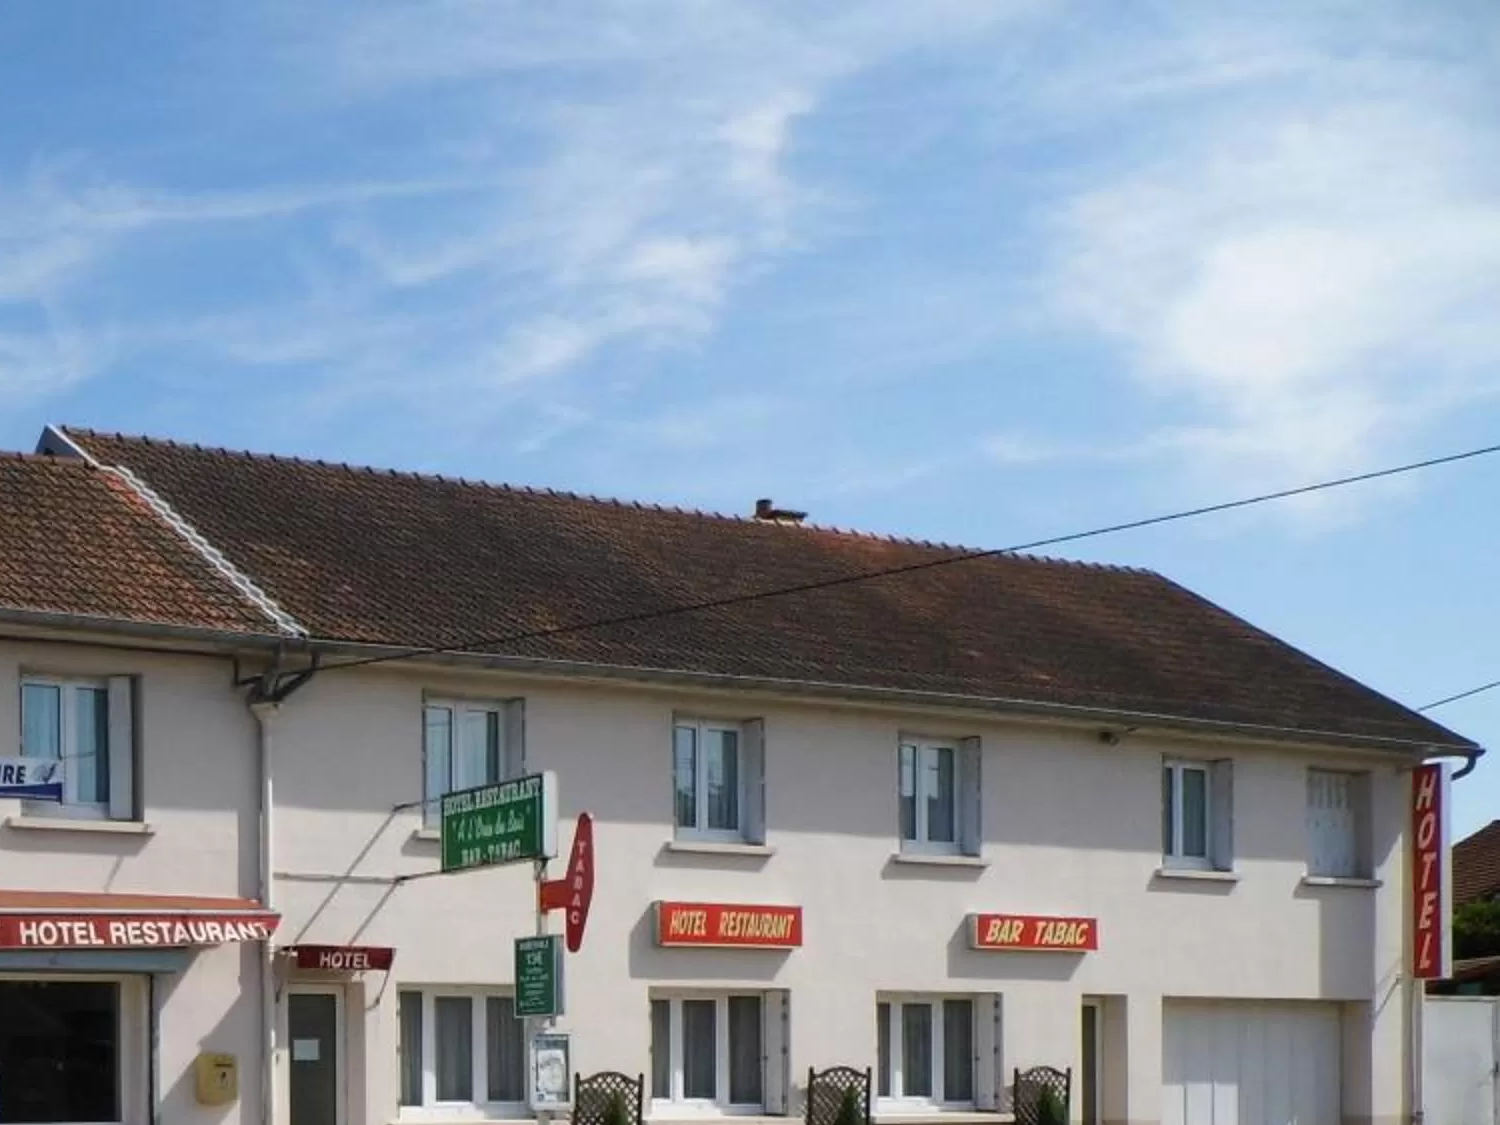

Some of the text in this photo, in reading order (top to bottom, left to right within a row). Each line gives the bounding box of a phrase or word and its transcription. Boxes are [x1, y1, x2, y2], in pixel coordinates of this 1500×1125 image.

[570, 842, 587, 925] TABAC
[1415, 771, 1438, 969] HOTEL
[19, 921, 105, 945] HOTEL
[109, 921, 270, 945] RESTAURANT
[669, 909, 795, 939] HOTEL RESTAURANT
[985, 918, 1090, 945] BAR TABAC
[319, 951, 371, 969] HOTEL
